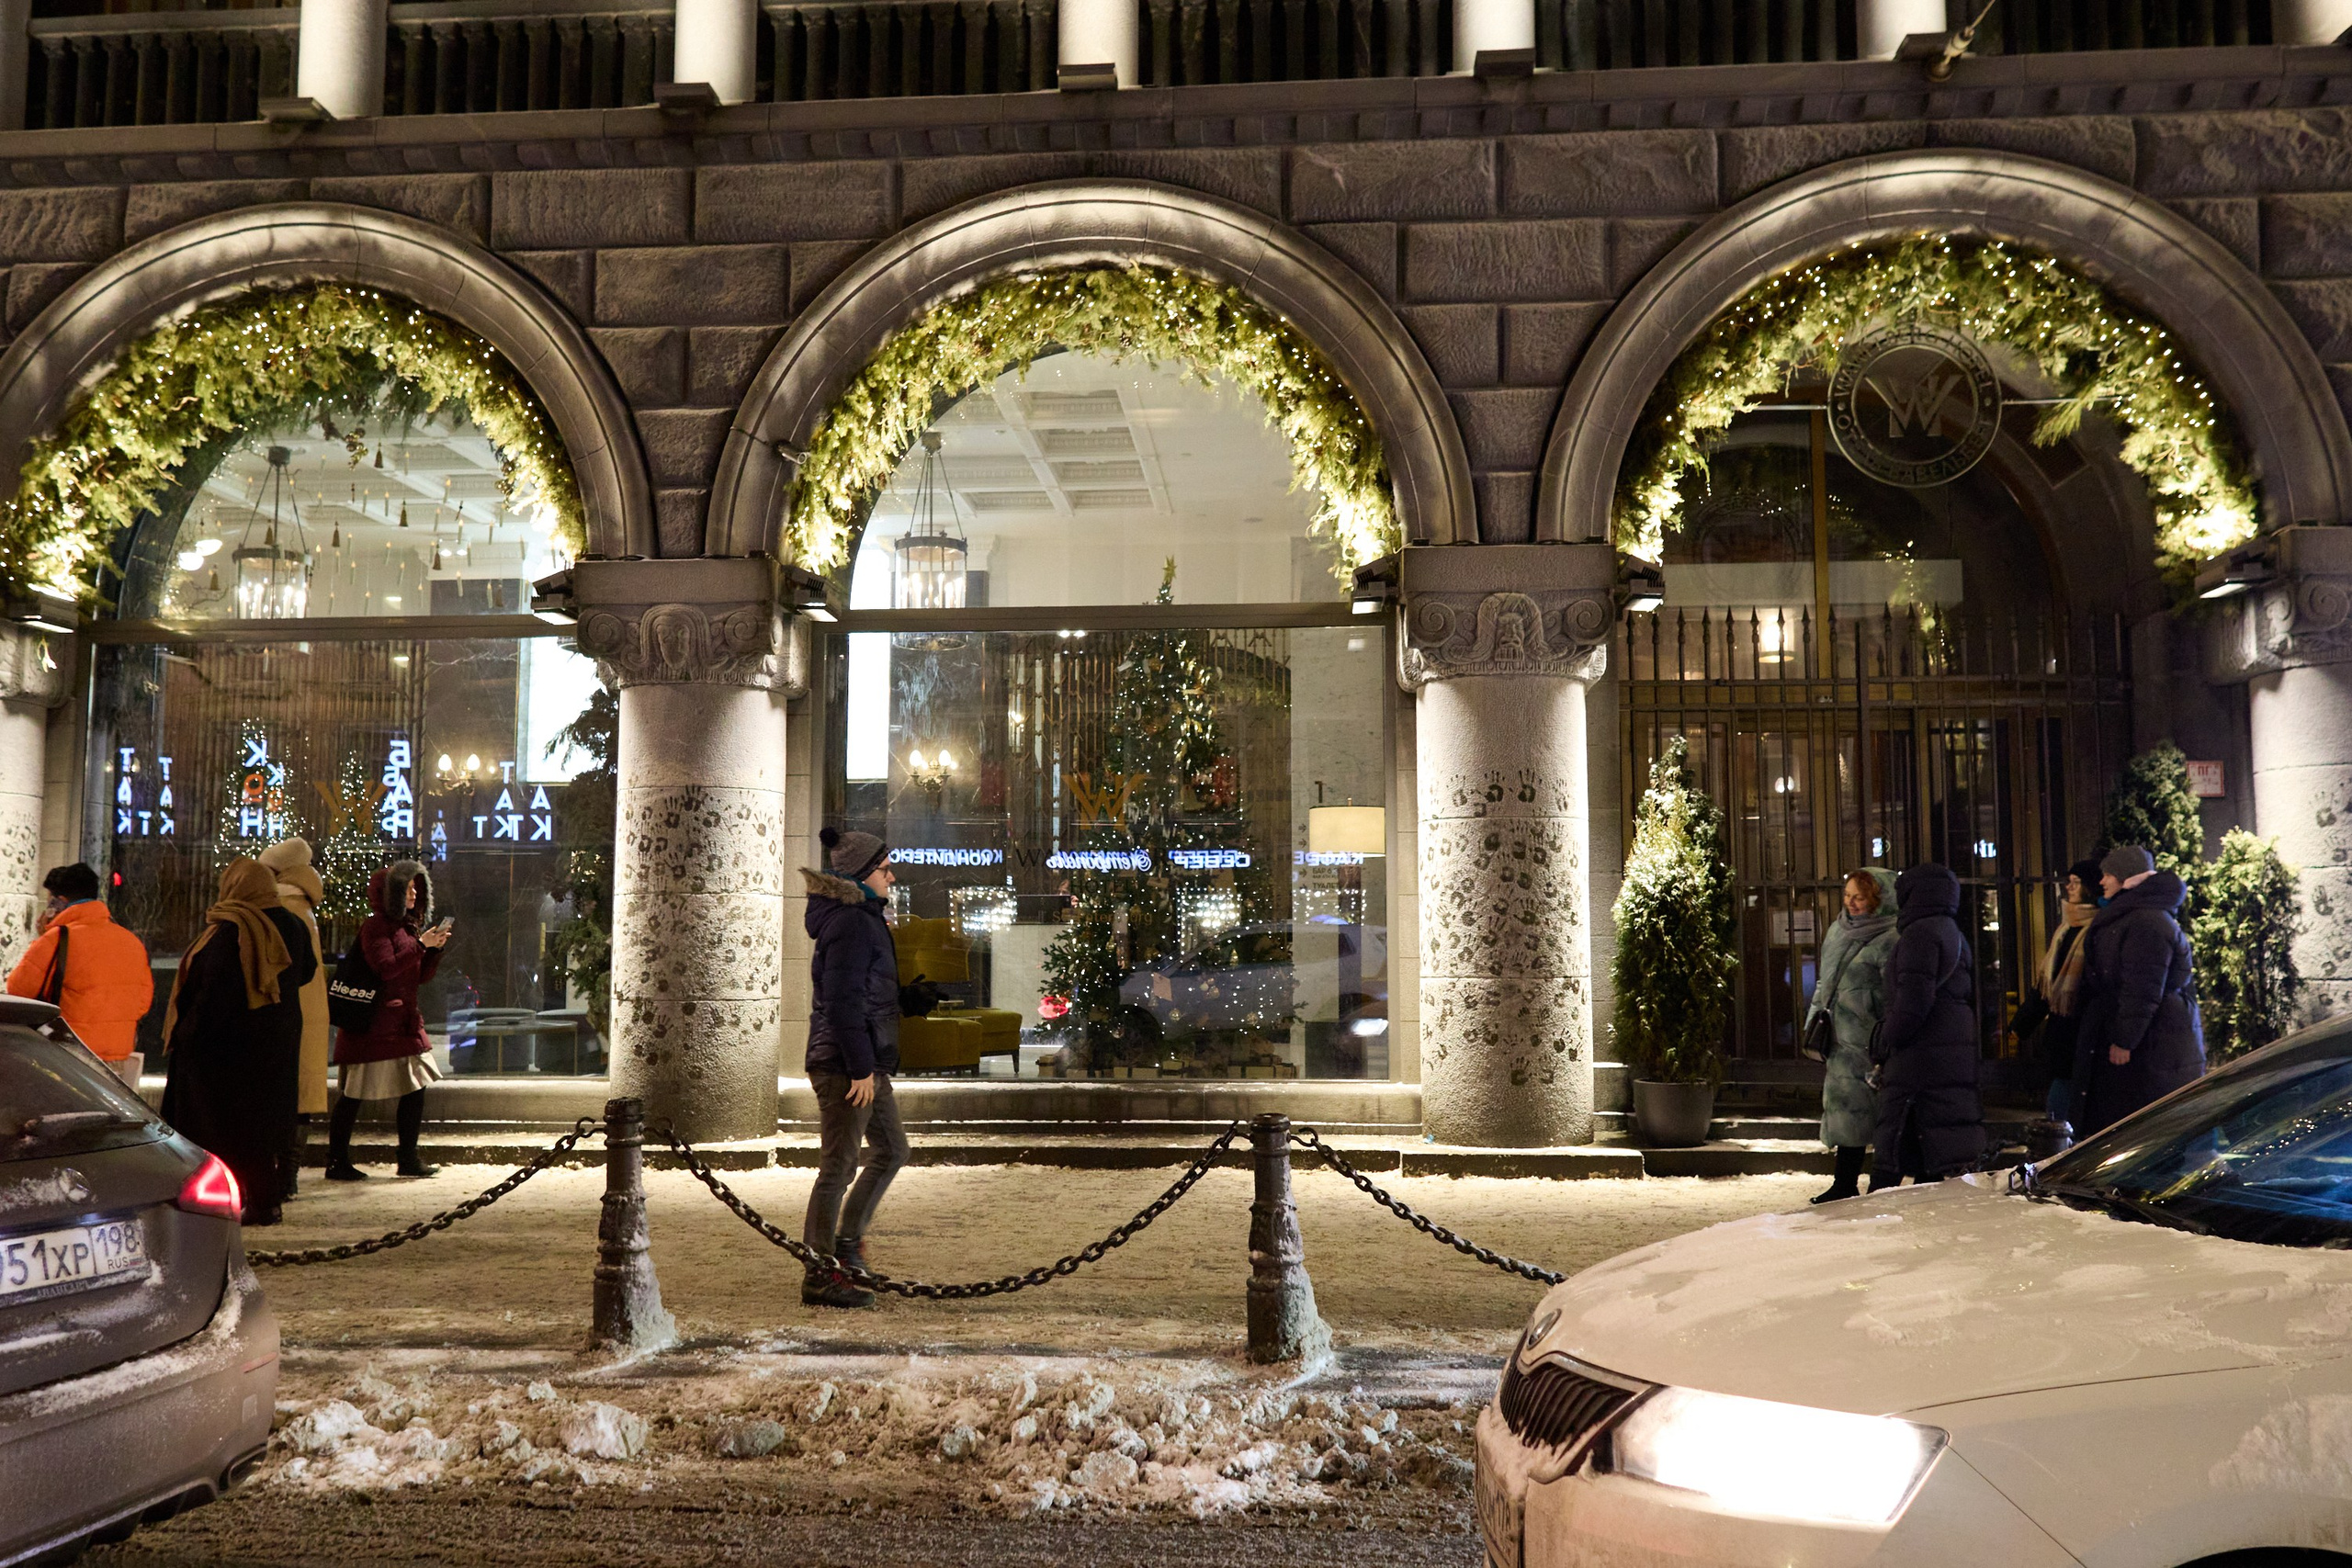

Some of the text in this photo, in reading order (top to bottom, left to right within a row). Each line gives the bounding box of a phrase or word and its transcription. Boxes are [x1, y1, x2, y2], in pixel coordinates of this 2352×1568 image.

[331, 979, 376, 999] biocad
[0, 1224, 137, 1286] 51ХР 198
[107, 1257, 130, 1270] RUS
